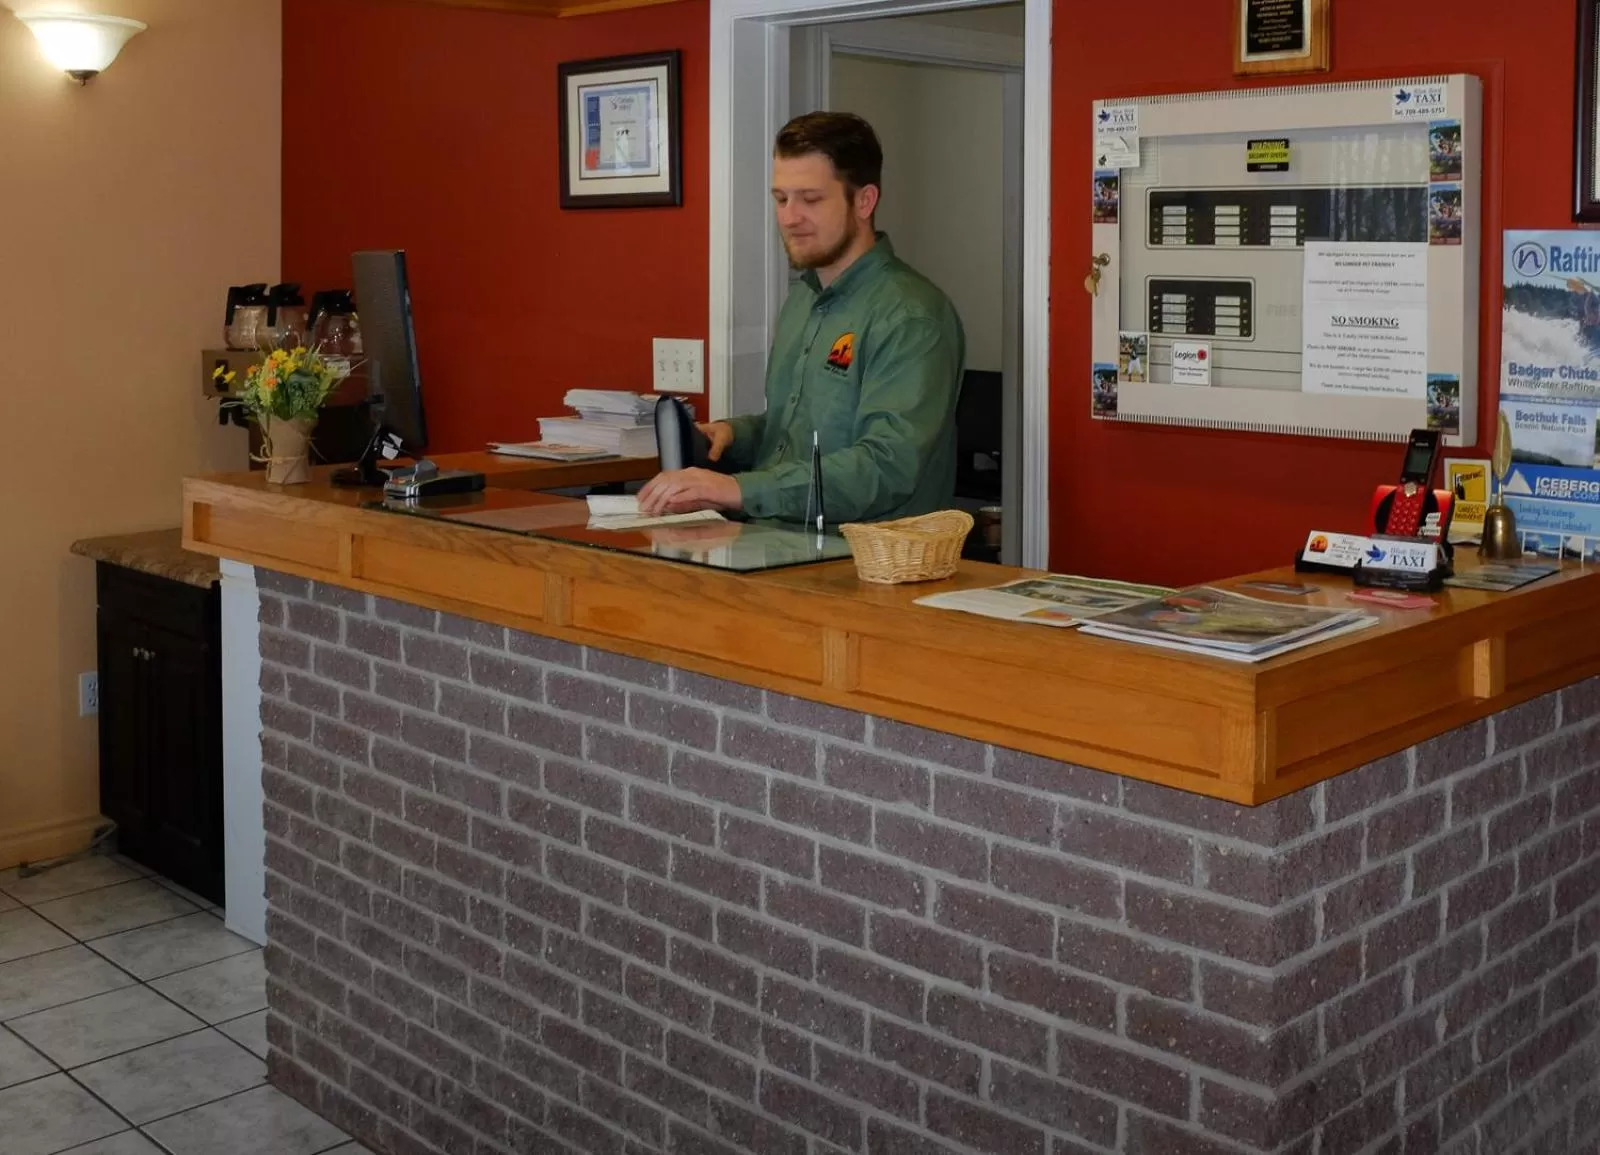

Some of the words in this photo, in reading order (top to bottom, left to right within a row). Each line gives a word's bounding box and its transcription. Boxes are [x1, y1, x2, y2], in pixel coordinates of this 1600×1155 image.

[1414, 93, 1441, 104] TAXI
[1112, 113, 1134, 123] TAXI
[1331, 315, 1347, 326] NO
[1348, 316, 1400, 328] SMOKING
[1175, 350, 1197, 360] Legion
[1508, 362, 1555, 380] Badger
[1561, 381, 1596, 393] Rafting
[1562, 414, 1587, 426] Falls
[1535, 476, 1600, 493] ICEBERG
[1391, 555, 1426, 568] TAXI
